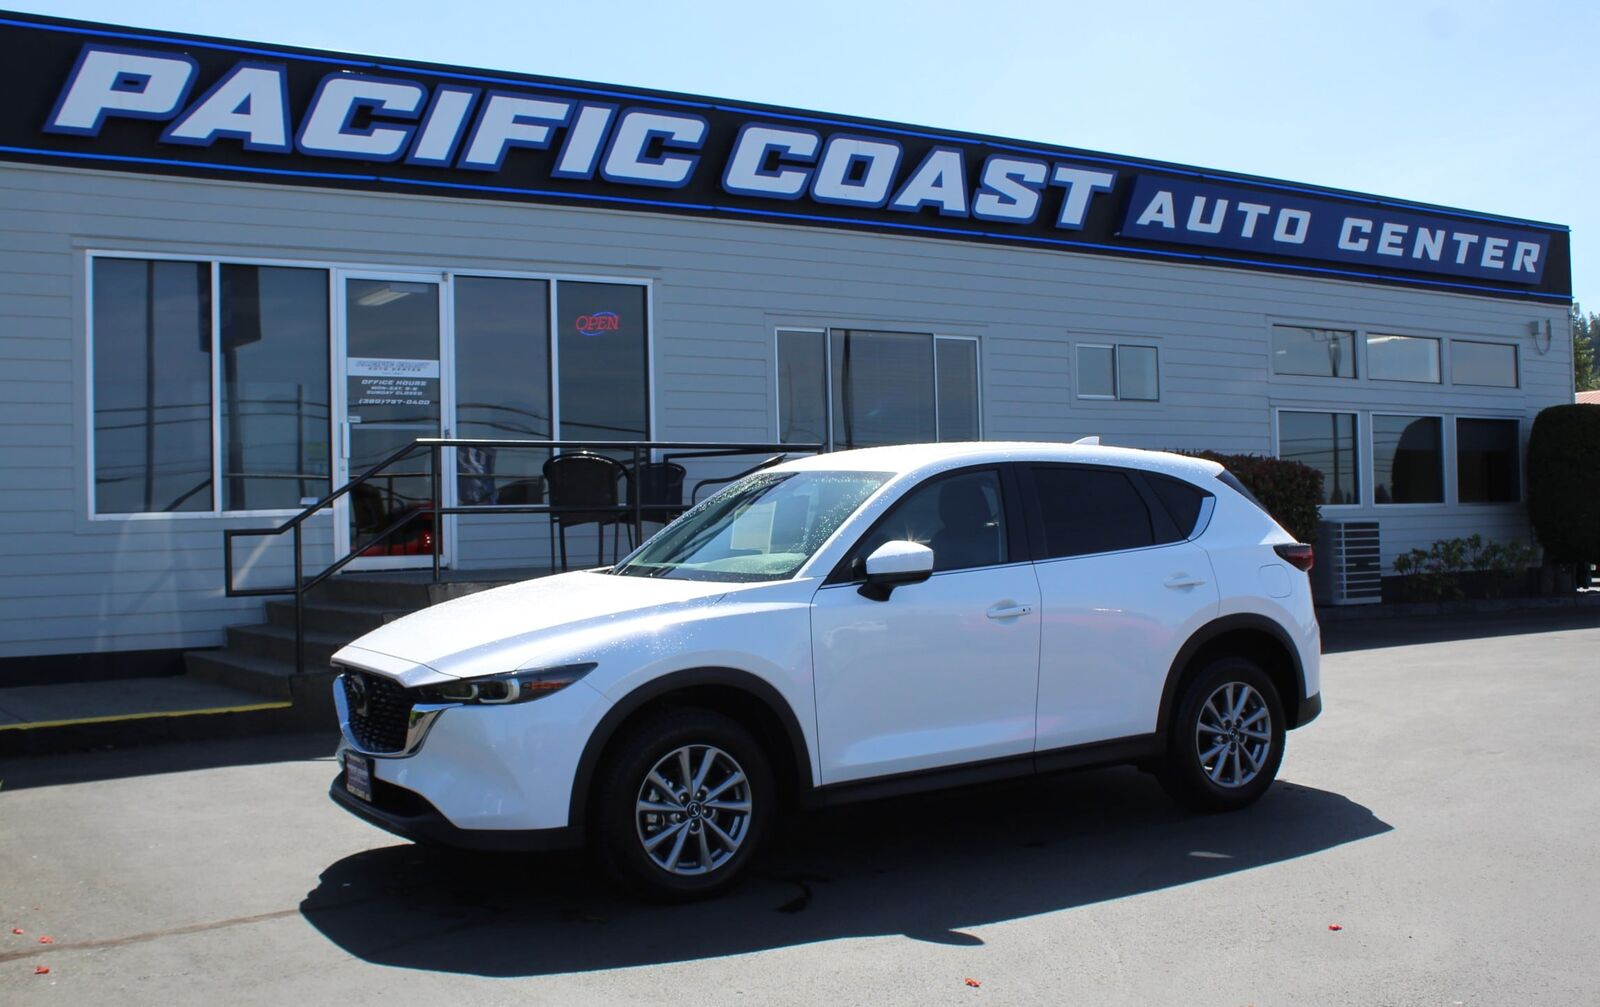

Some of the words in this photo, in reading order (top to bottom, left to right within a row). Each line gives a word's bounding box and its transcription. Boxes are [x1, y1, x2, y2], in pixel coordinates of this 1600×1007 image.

[51, 49, 706, 184] PACIFIC
[725, 126, 1114, 226] COAST
[1136, 190, 1311, 245] AUTO
[1338, 217, 1542, 275] CENTER
[575, 315, 620, 331] OPEN
